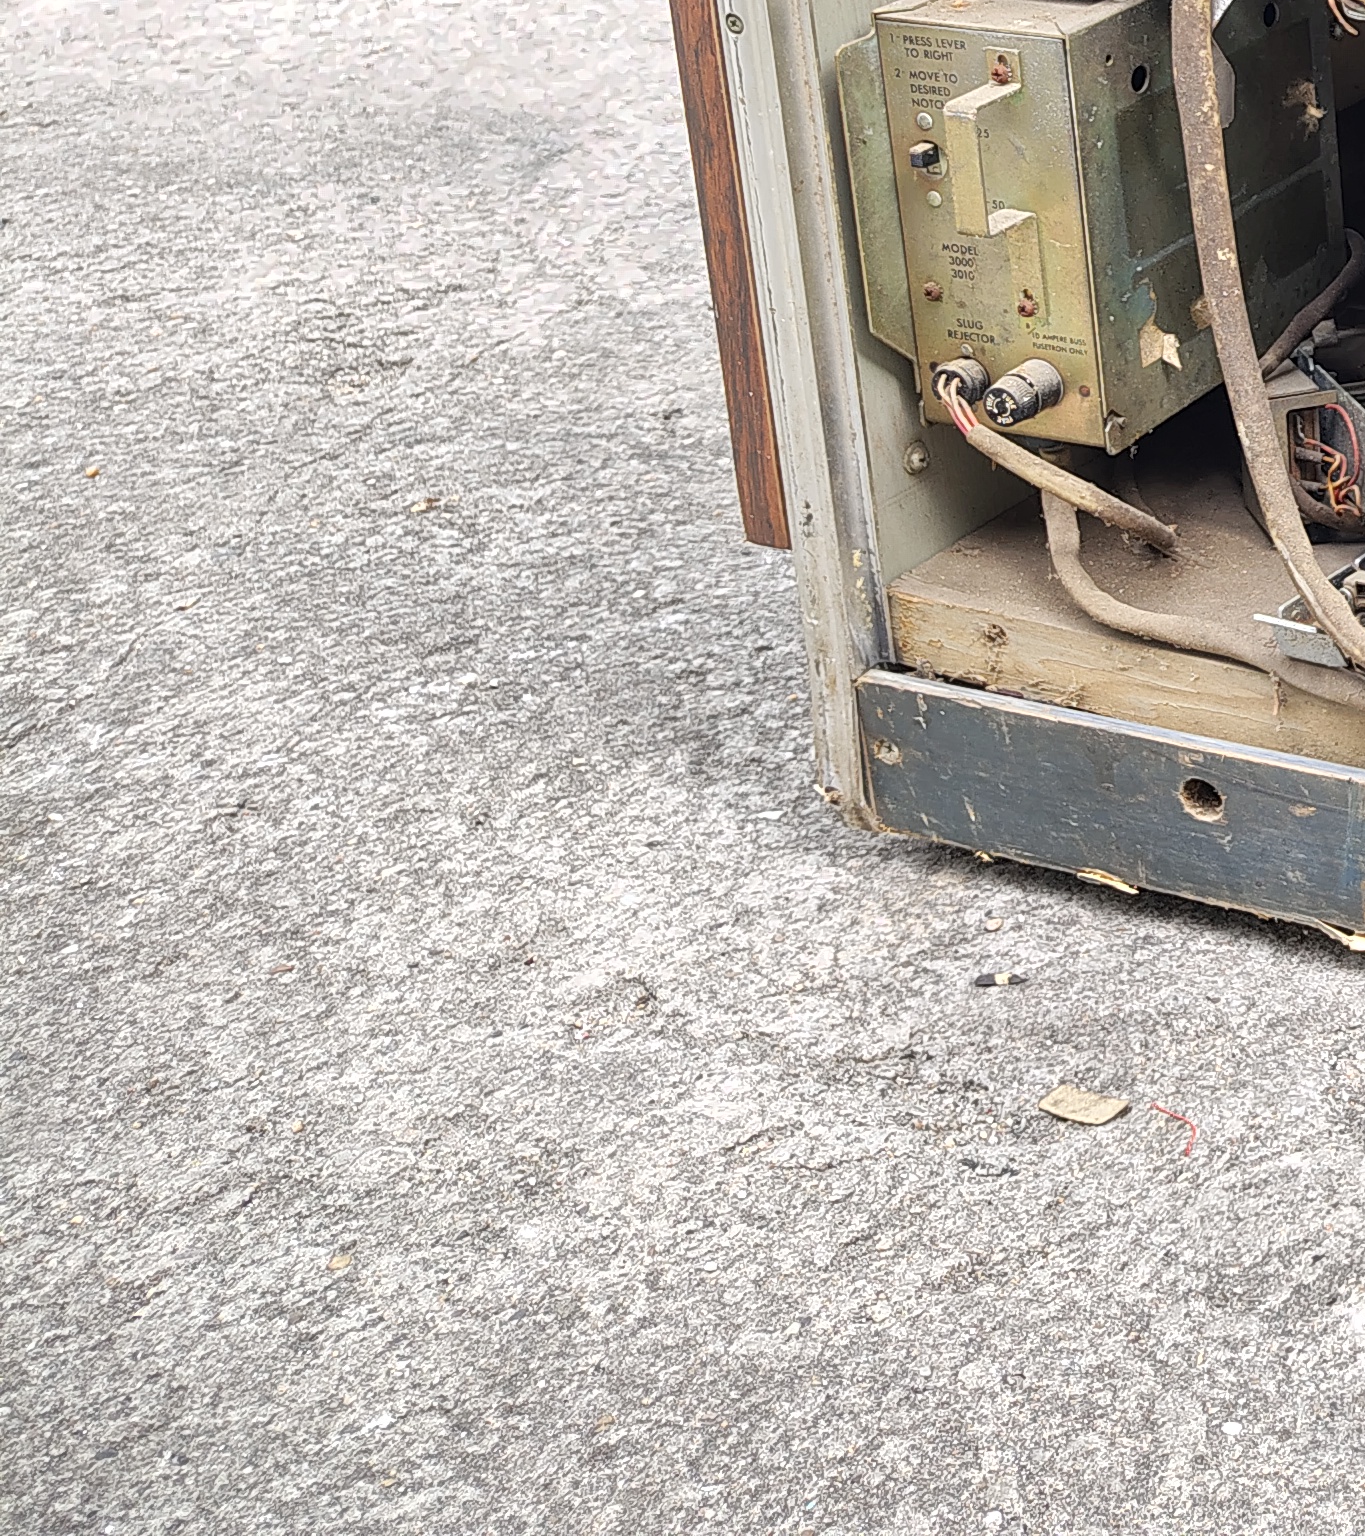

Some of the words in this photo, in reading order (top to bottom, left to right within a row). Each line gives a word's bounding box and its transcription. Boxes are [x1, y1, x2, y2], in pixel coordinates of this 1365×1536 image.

[902, 35, 932, 47] PRESS
[936, 38, 966, 50] LEVER
[904, 47, 919, 58] TO
[924, 50, 954, 61] RIGHT
[909, 70, 940, 82] MOVE
[944, 73, 958, 84] TO
[910, 84, 950, 96] DESIRED
[912, 98, 945, 110] NOTC
[976, 128, 990, 138] 25
[992, 200, 1006, 210] 50
[942, 243, 978, 256] MODEL
[948, 256, 974, 268] 3000
[956, 318, 983, 330] SLUG
[947, 330, 995, 344] REJECTOR
[1042, 334, 1068, 344] AMPERE
[1070, 336, 1086, 346] BUSS
[1032, 342, 1068, 354] FUSETRON
[1069, 346, 1088, 356] ONLY
